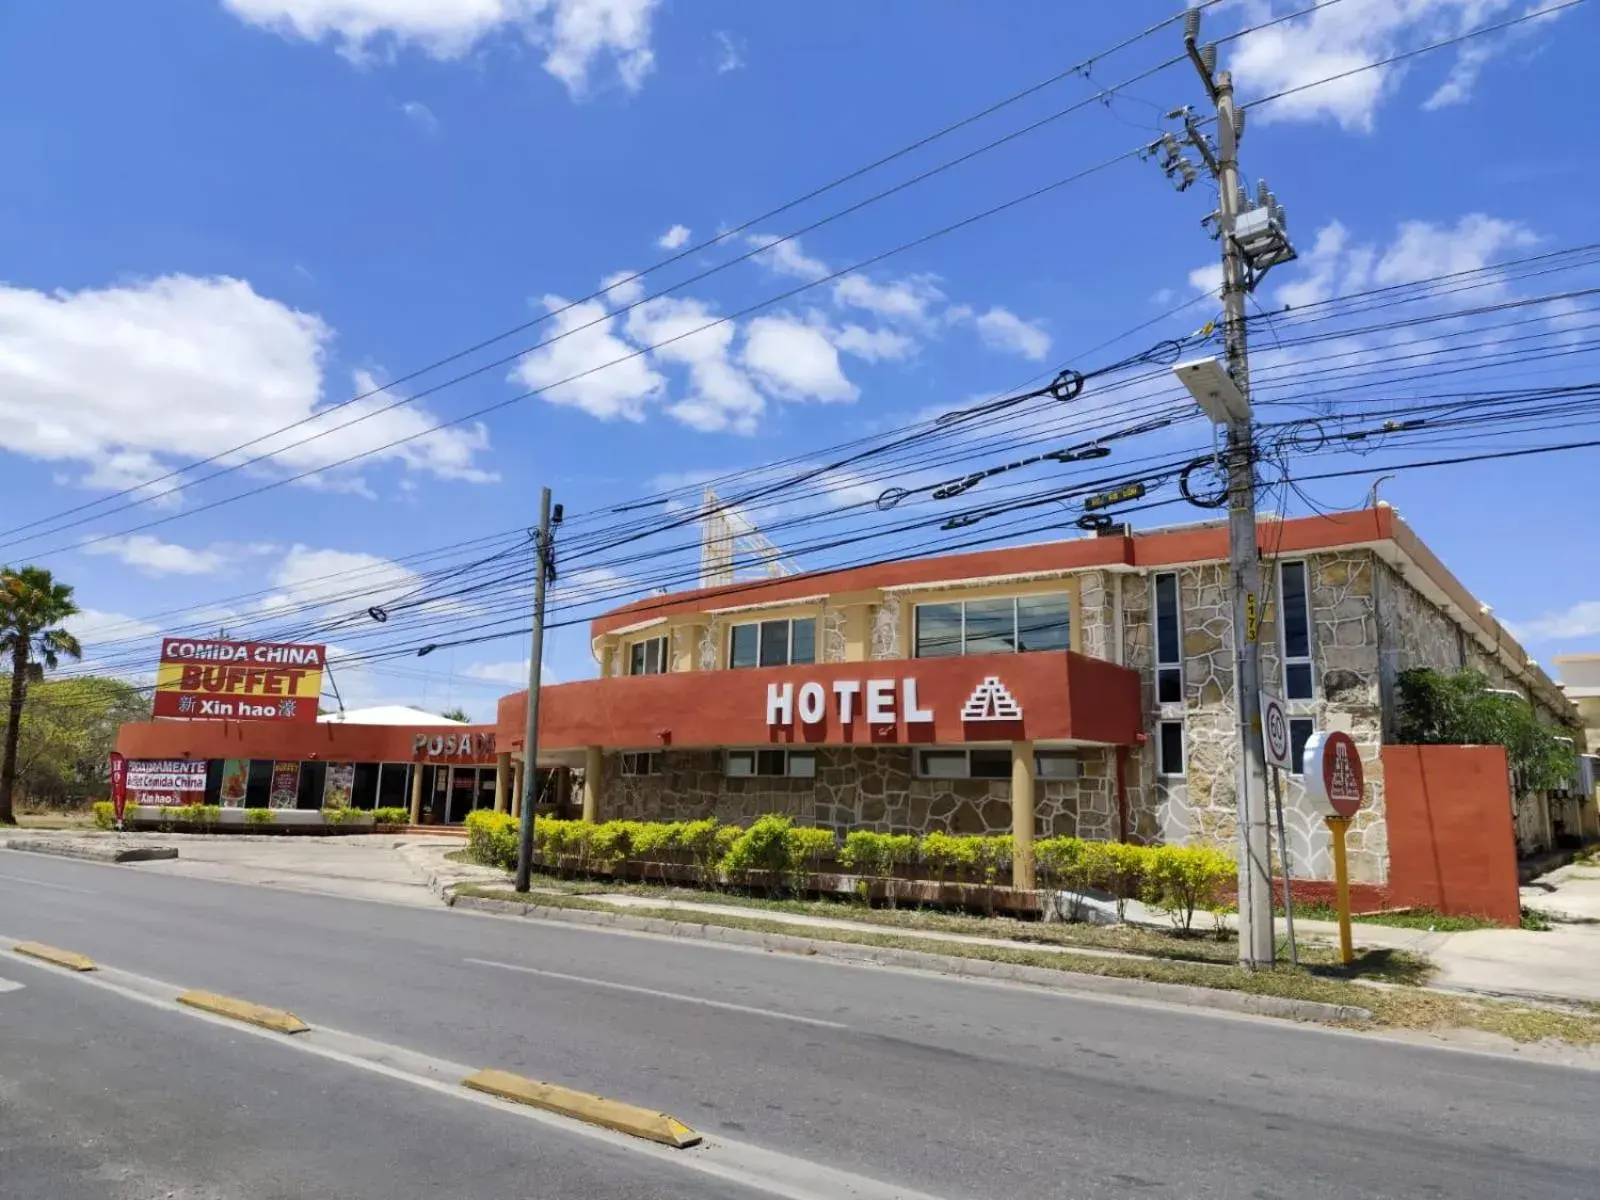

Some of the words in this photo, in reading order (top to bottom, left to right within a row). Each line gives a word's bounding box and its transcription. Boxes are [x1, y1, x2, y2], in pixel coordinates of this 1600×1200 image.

[166, 642, 249, 662] COMIDA
[254, 646, 320, 665] CHINA
[180, 665, 305, 696] BUFFET
[200, 700, 233, 715] Xin
[238, 701, 276, 717] hao
[766, 677, 934, 725] HOTEL
[128, 760, 206, 773] IMAMENTE
[144, 776, 173, 787] Comida
[175, 776, 203, 788] China
[155, 792, 172, 804] hao
